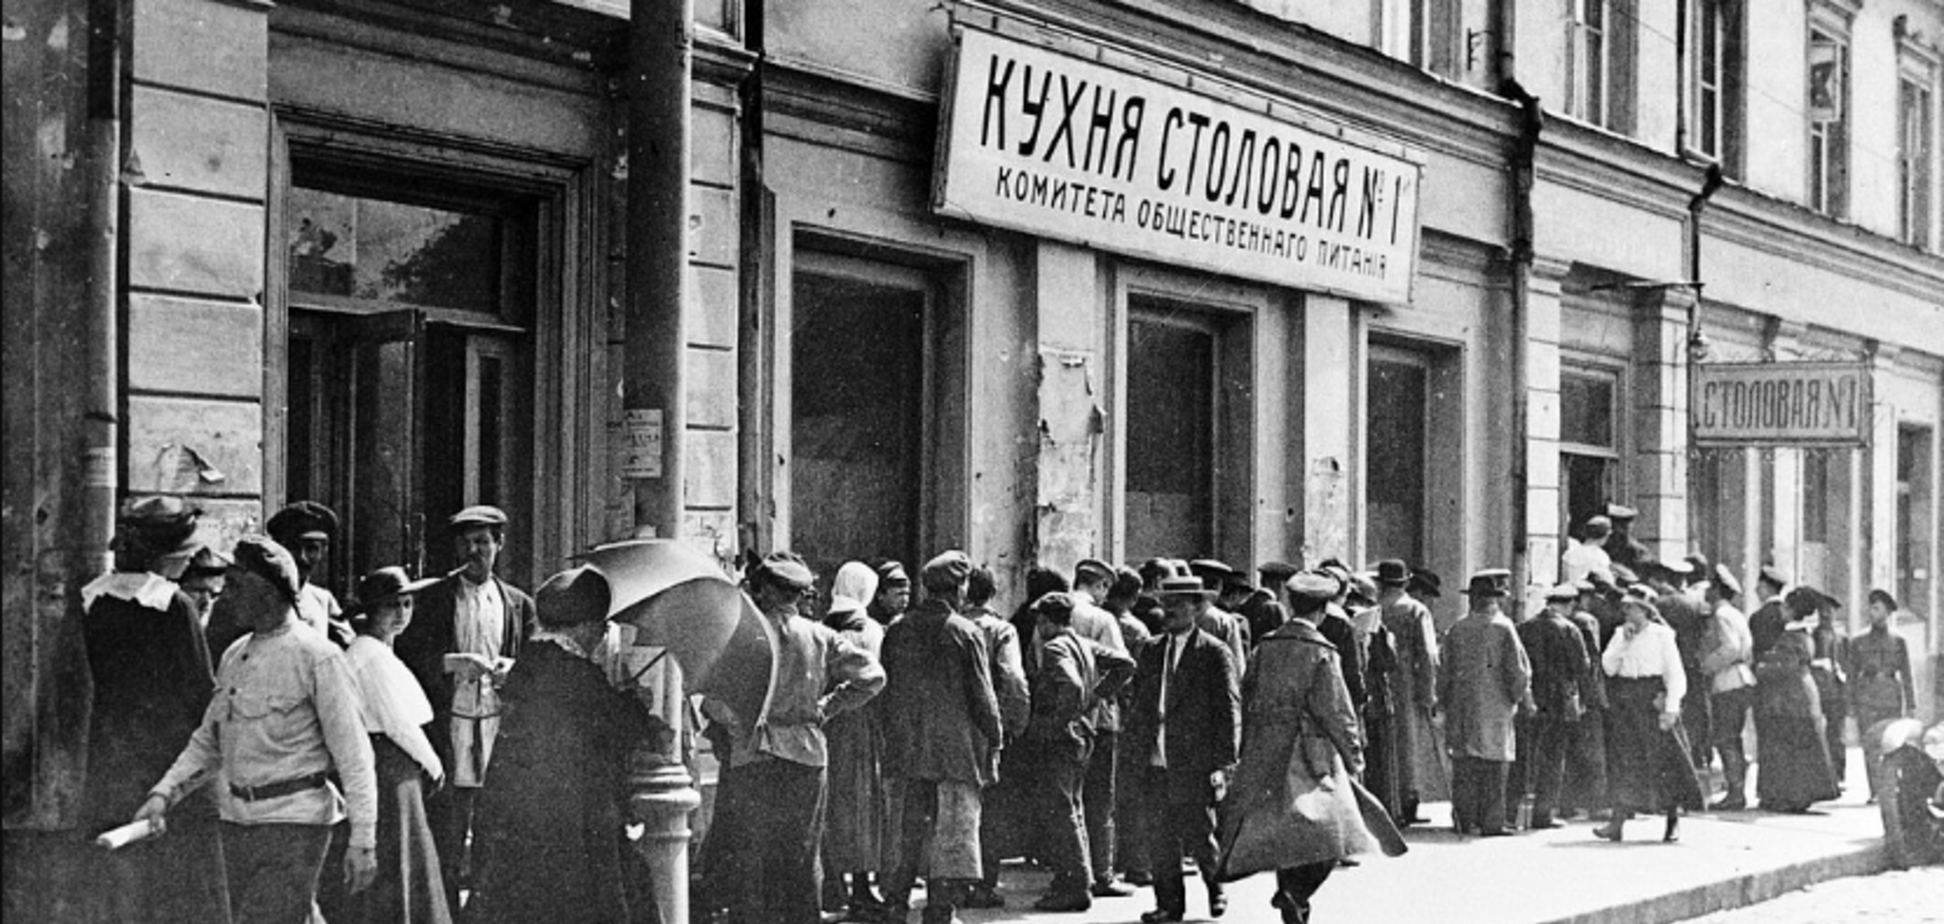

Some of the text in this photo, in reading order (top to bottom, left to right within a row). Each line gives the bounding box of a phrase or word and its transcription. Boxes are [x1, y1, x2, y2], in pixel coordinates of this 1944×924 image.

[980, 54, 1146, 182] КУХНЯ
[1157, 106, 1350, 233] СТОЛОВАЯ
[996, 165, 1126, 223] КОМИТЕТА
[1137, 198, 1307, 262] ОБЩЕСТВЕННАГО
[1704, 379, 1820, 429] СТОЛОВАЯ
